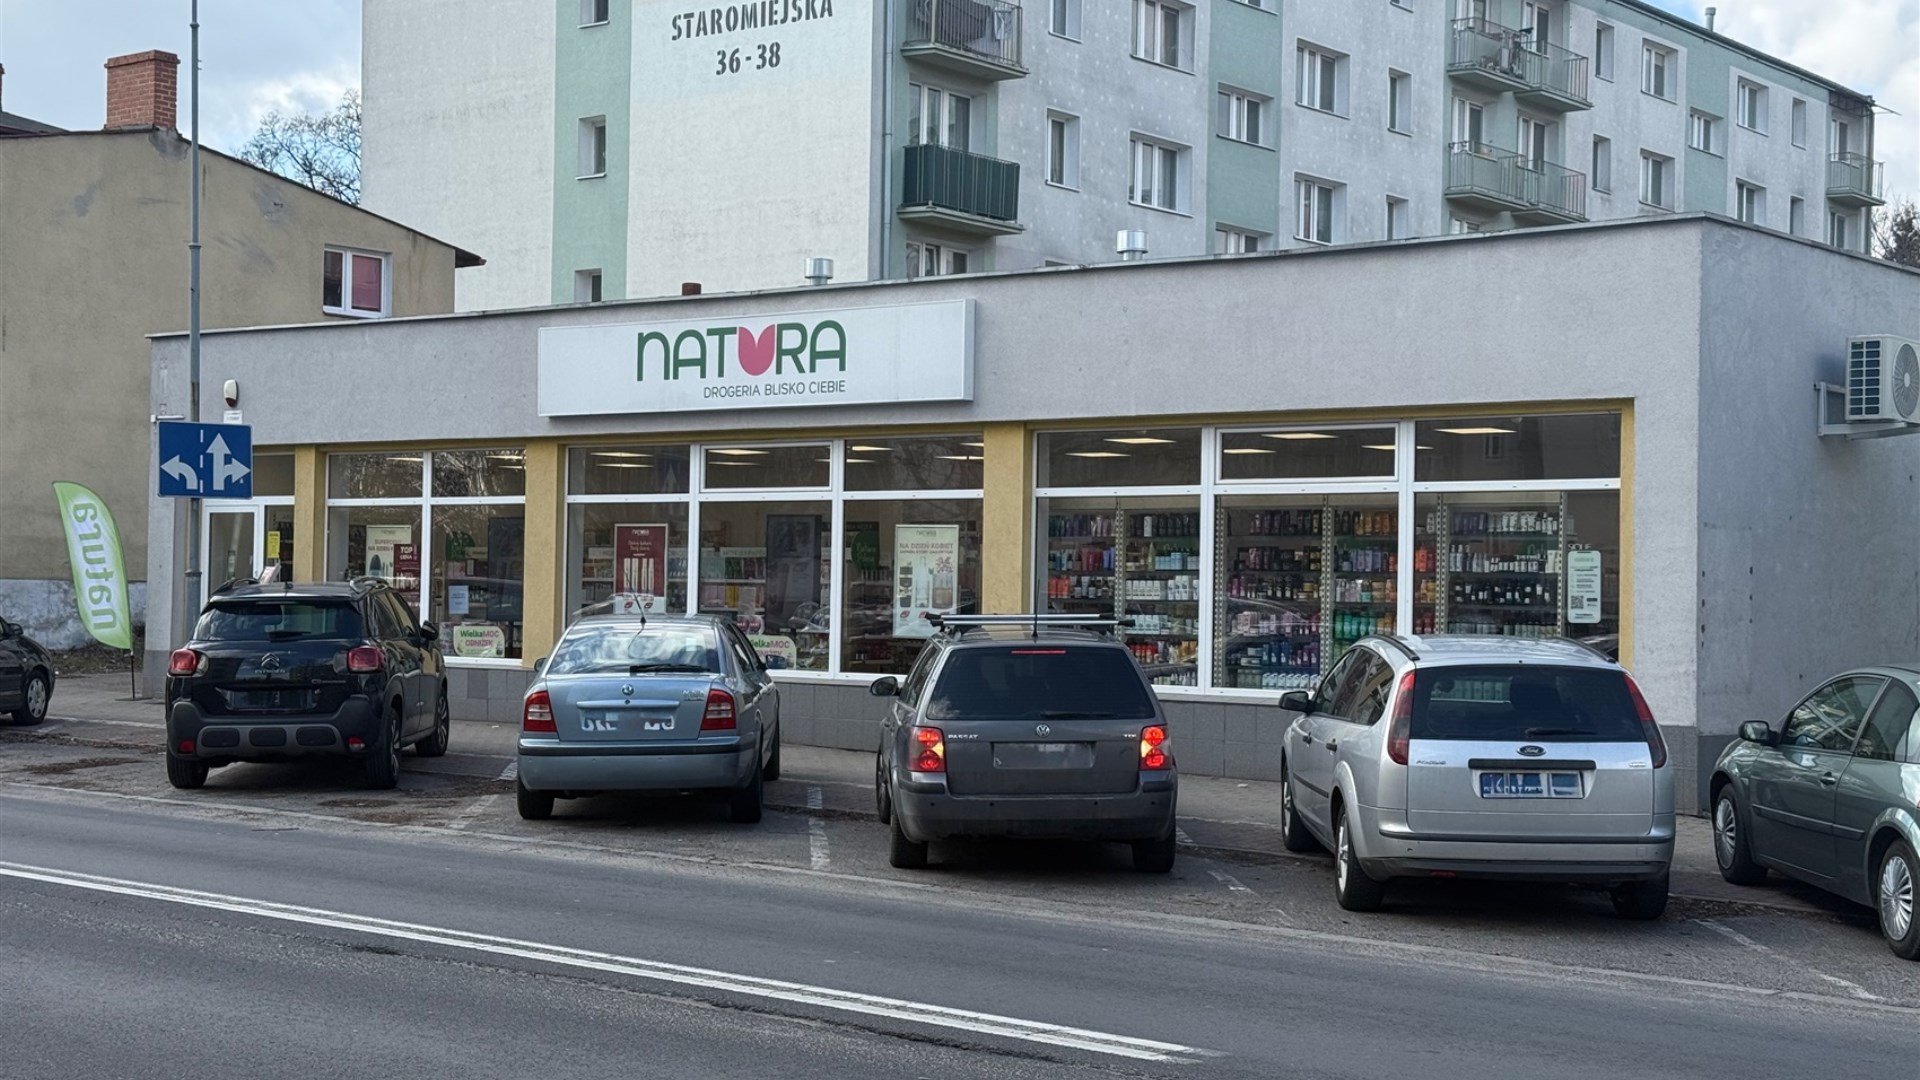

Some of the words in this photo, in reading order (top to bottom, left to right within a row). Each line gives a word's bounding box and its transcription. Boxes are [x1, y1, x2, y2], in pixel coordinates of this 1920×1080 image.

[671, 0, 833, 41] STAROMIEJSKA
[636, 319, 847, 382] NATURA
[704, 383, 761, 399] DROGERIA
[764, 381, 806, 396] BLISKO
[809, 379, 846, 394] CIEBIE
[400, 546, 413, 554] TOP
